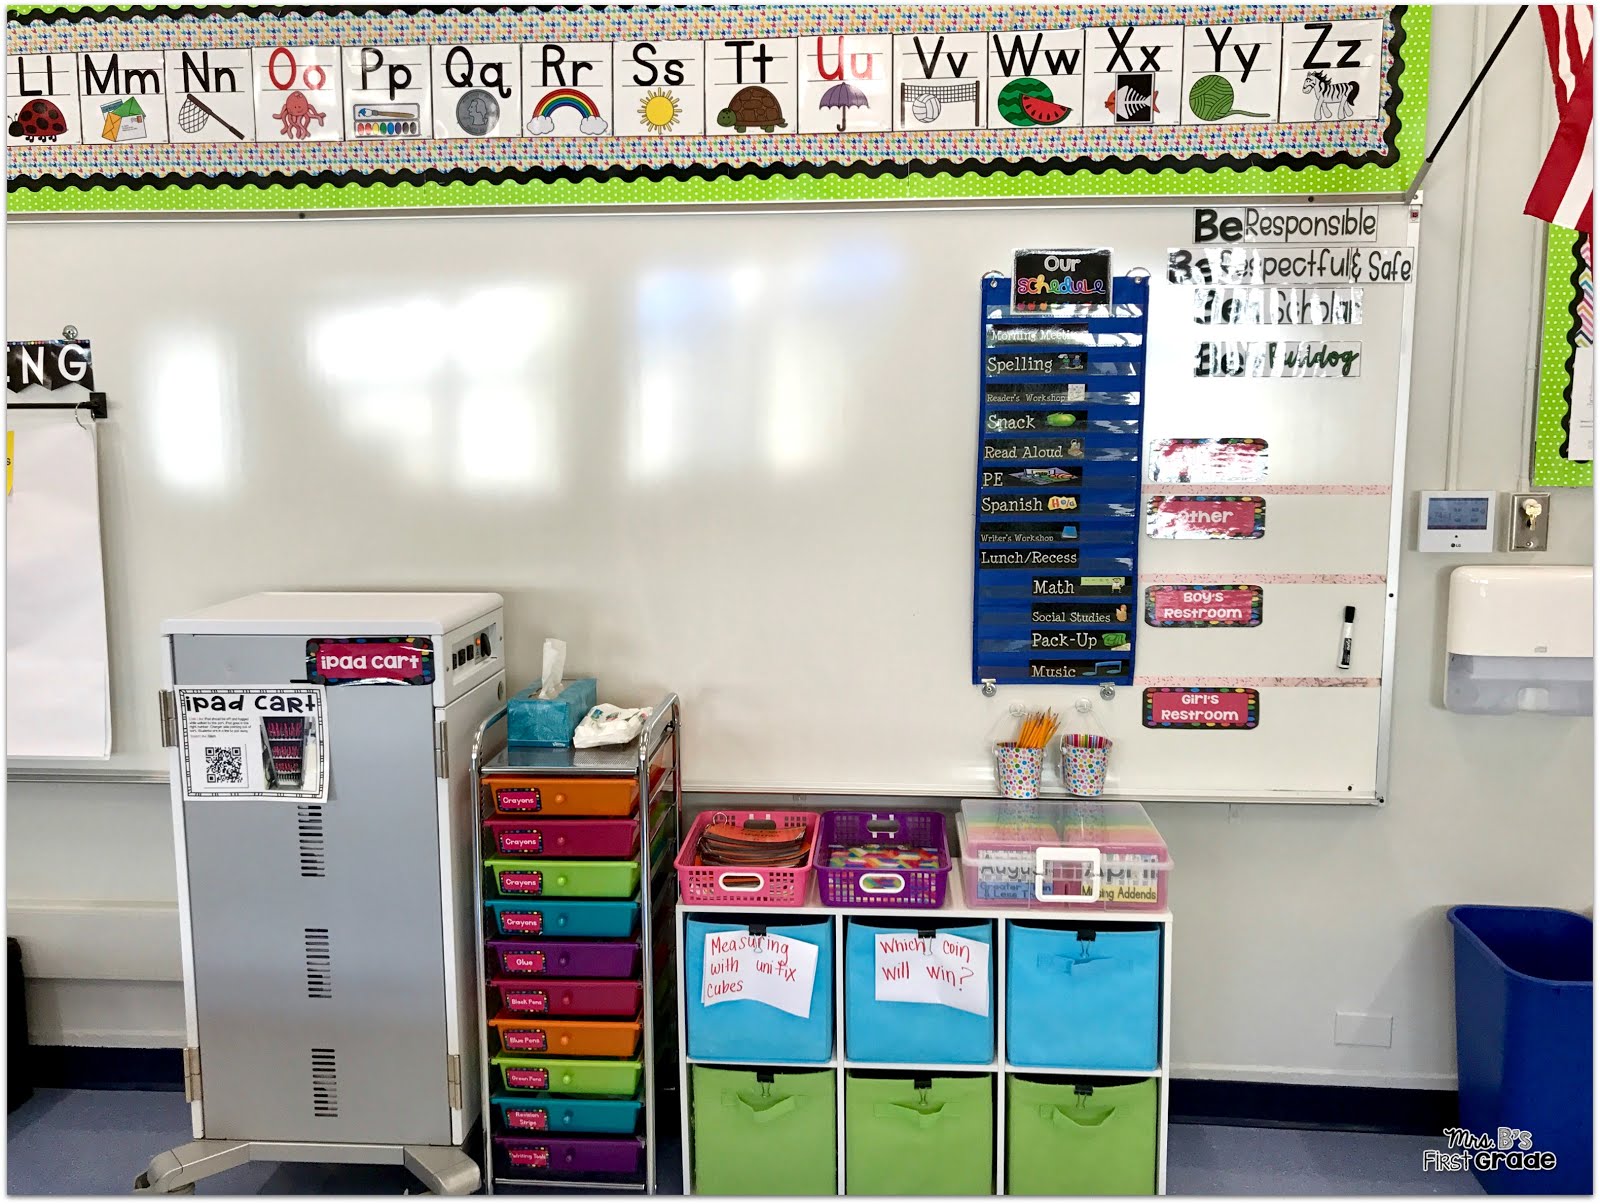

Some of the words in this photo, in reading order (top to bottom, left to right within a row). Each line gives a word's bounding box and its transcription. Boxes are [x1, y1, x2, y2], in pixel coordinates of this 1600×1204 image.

[84, 53, 160, 95] Mm
[182, 51, 237, 93] Nn
[268, 46, 326, 91] Oo
[361, 47, 413, 100] Pp
[445, 45, 512, 99] Qq
[542, 44, 593, 87] Rr
[632, 42, 685, 86] Ss
[724, 40, 774, 84] Tt
[816, 36, 874, 81] Uu
[913, 35, 968, 79] Vv
[993, 32, 1080, 77] Ww
[1106, 26, 1161, 73] Xx
[1205, 26, 1261, 83] Yy
[1303, 22, 1362, 69] Zz
[1194, 208, 1243, 243] Be
[1245, 207, 1376, 242] Responsible
[1044, 255, 1081, 271] Our
[1369, 251, 1411, 281] Safe
[991, 330, 1036, 342] Morning
[1040, 330, 1074, 341] Meeti
[7, 344, 87, 385] NG
[987, 357, 1053, 374] Spelling
[987, 393, 1021, 402] Reader's
[1025, 393, 1066, 403] Workshop
[987, 414, 1036, 430] Snack
[984, 446, 1017, 459] Read
[1022, 446, 1063, 458] Aloud
[983, 472, 1004, 487] PE
[981, 497, 1043, 514] Spanish
[981, 534, 1012, 542] Writer's
[1014, 534, 1054, 542] Workshop
[981, 551, 1077, 564] Lunch/Recess
[1033, 580, 1075, 595] Math
[1032, 612, 1065, 622] Social
[1069, 612, 1111, 623] Studies
[1164, 608, 1243, 619] Restroom
[1031, 632, 1097, 649] Pack-Up
[1031, 665, 1077, 678] Music
[1161, 709, 1239, 721] Restroom
[502, 797, 535, 805] Crayons
[505, 838, 537, 846] Crayons
[505, 878, 537, 887] Crayons
[1082, 885, 1114, 901] Mising
[1117, 886, 1157, 900] Addends
[506, 919, 538, 927] Crayons
[710, 936, 790, 966] Measuring
[880, 937, 926, 955] Which
[710, 957, 739, 975] with
[706, 979, 744, 999] cubes
